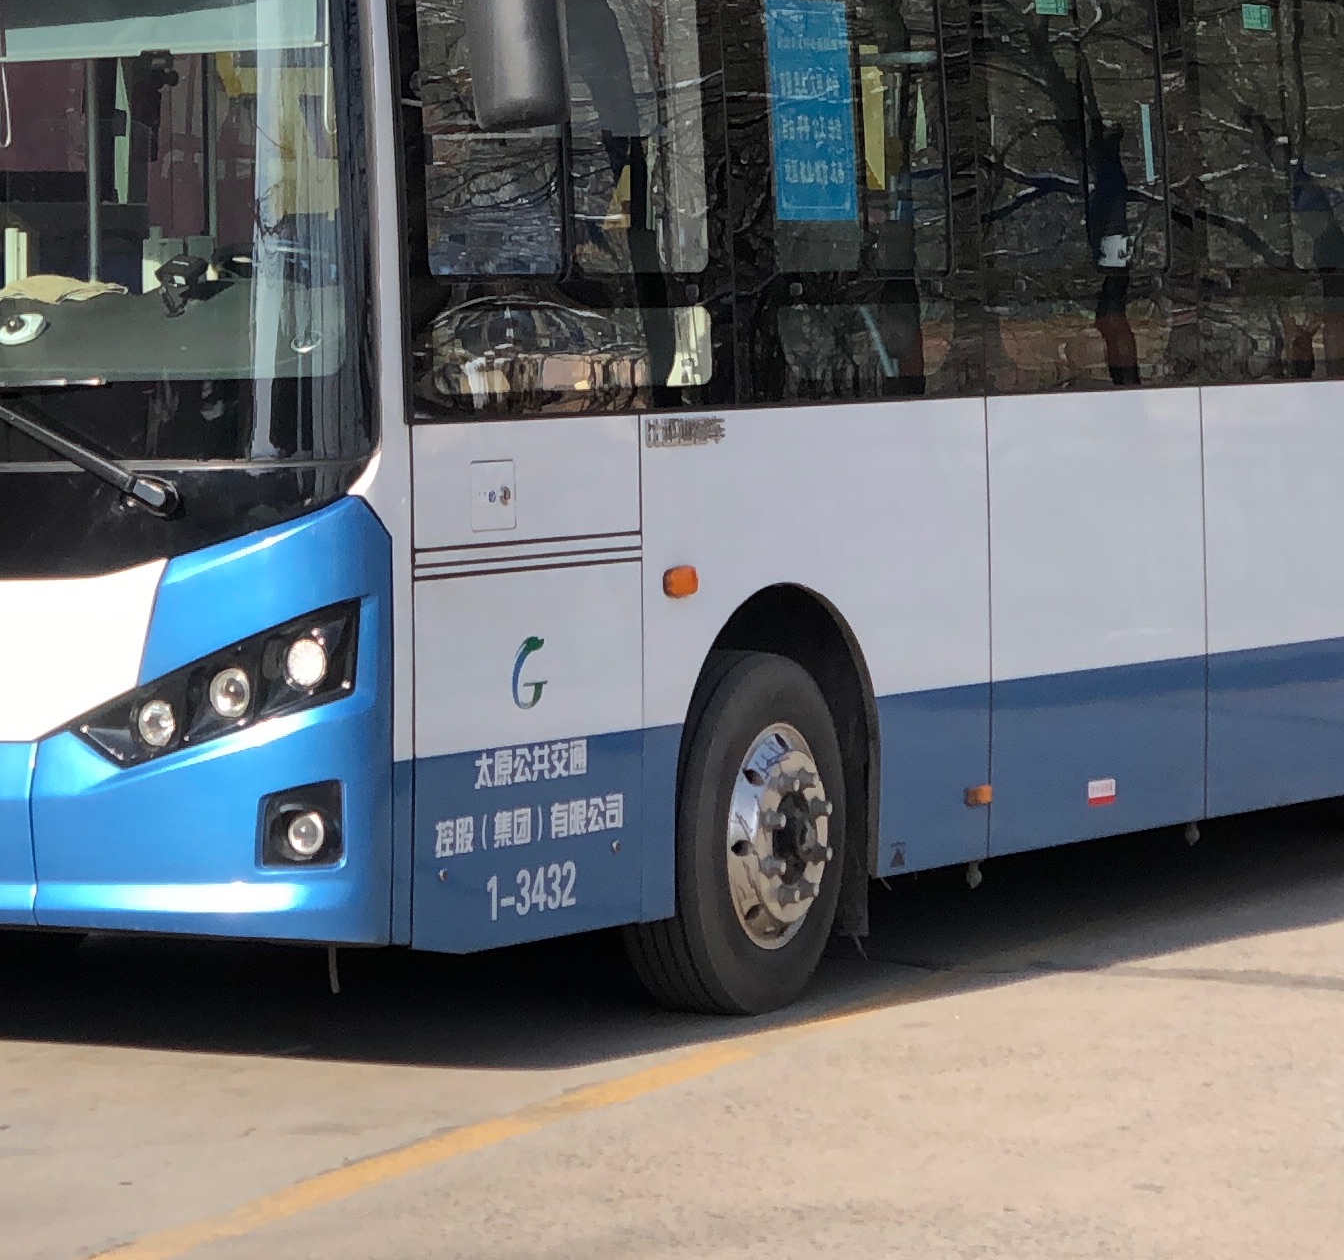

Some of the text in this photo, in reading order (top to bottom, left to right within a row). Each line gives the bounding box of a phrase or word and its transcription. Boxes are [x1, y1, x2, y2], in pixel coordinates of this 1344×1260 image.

[473, 738, 588, 790] 太原公共交通
[486, 859, 577, 921] 1-3432
